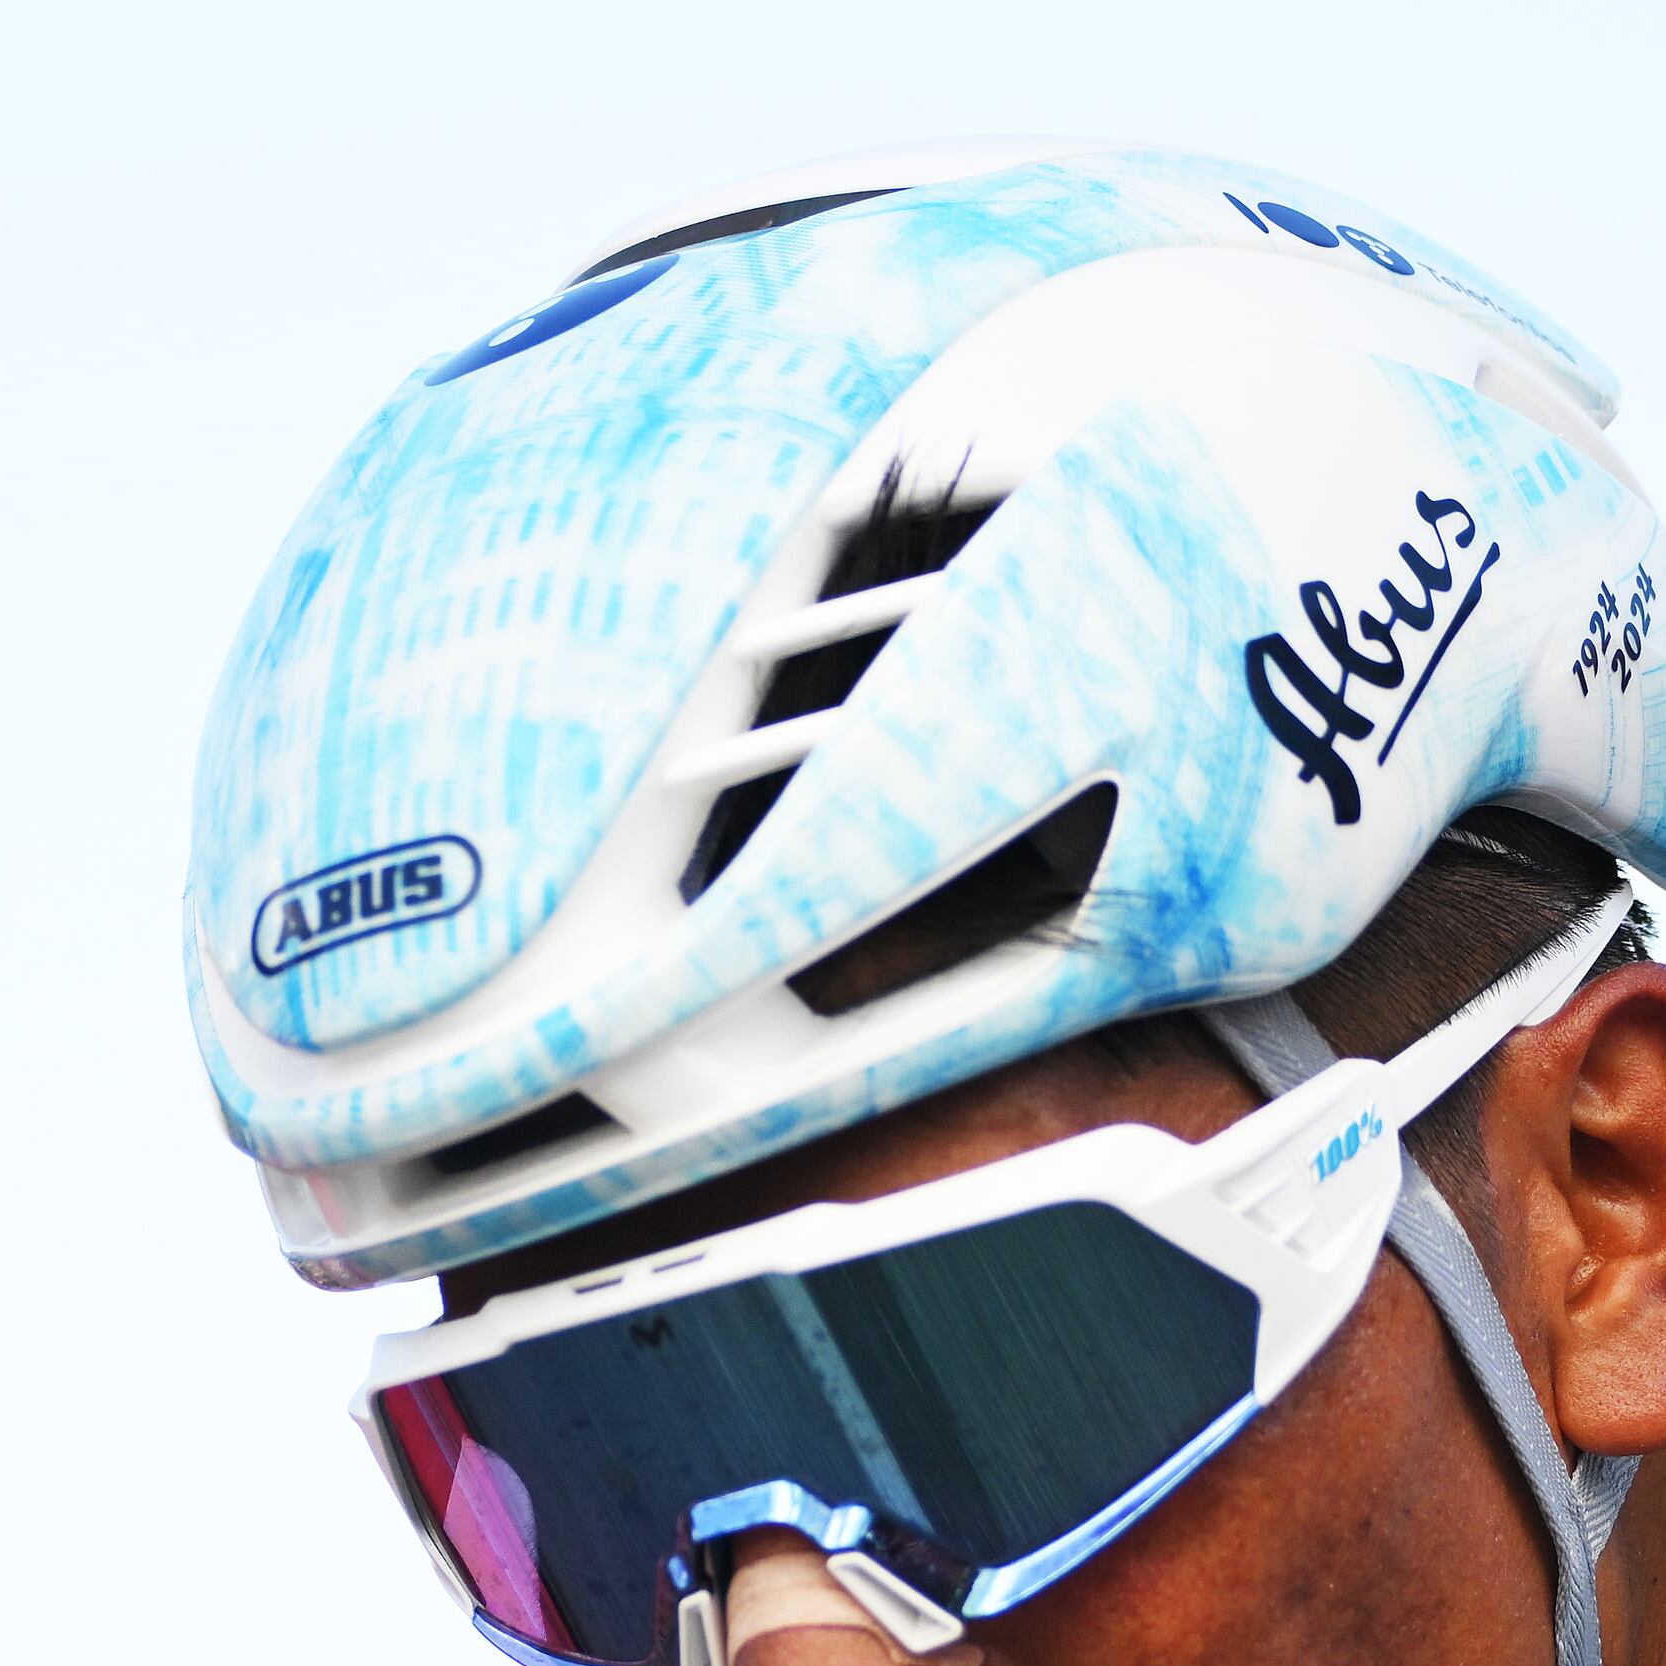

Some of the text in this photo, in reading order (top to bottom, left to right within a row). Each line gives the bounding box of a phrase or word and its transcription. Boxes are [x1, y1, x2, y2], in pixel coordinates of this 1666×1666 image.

[1243, 490, 1476, 826] Abus
[1572, 580, 1619, 698] 1924
[1611, 562, 1656, 694] 2024
[275, 854, 444, 954] ABUS
[1306, 1100, 1383, 1186] 100%
